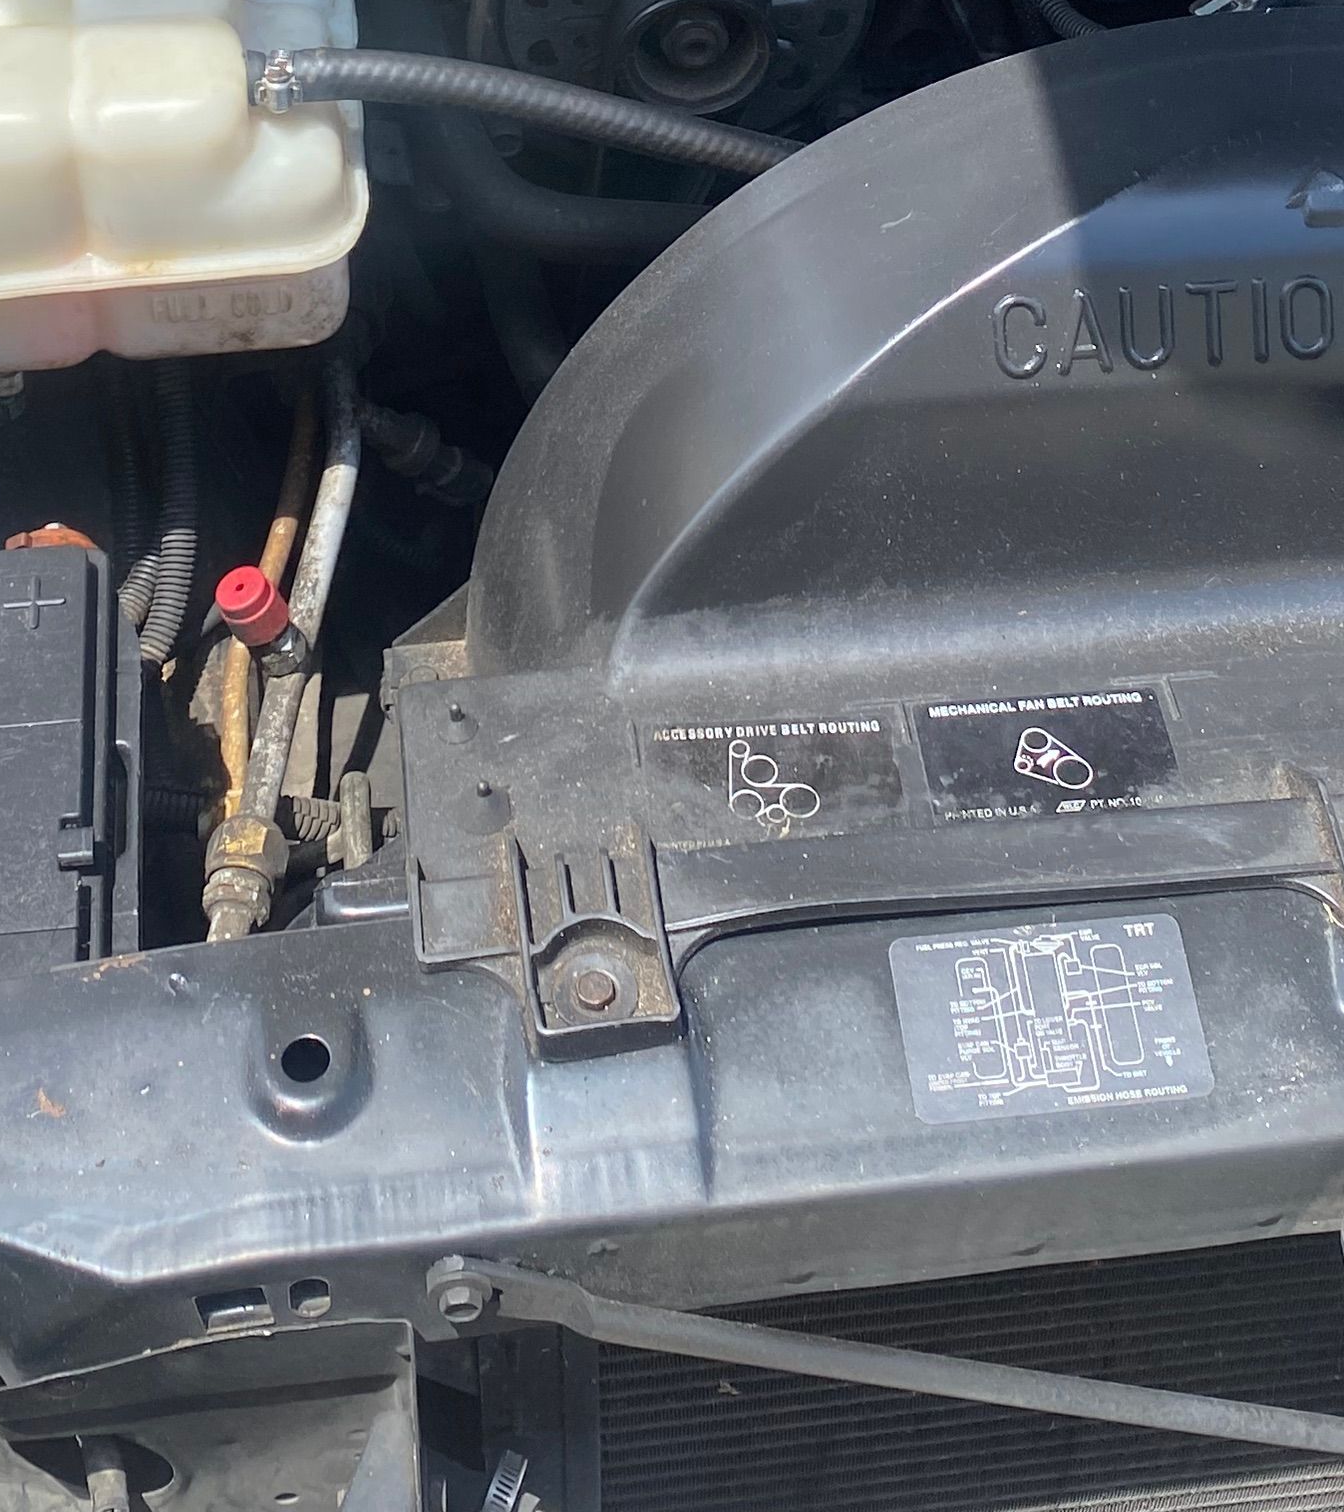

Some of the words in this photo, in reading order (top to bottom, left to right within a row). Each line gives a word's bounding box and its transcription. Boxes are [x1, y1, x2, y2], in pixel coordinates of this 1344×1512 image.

[928, 701, 1016, 718] MECHANICAL
[1018, 698, 1045, 711] FAN
[1047, 696, 1079, 709] BELT
[1082, 691, 1141, 706] ROUTING
[653, 726, 732, 742] ACCESSORY
[735, 724, 776, 738] DRIVE
[781, 722, 815, 735] BELT
[818, 718, 880, 735] ROUTING
[945, 809, 993, 821] PNTED
[1122, 922, 1155, 938] TRT
[1067, 1092, 1113, 1105] EMISSION
[1115, 1088, 1142, 1100] HOSE
[1144, 1084, 1188, 1097] ROUTING
